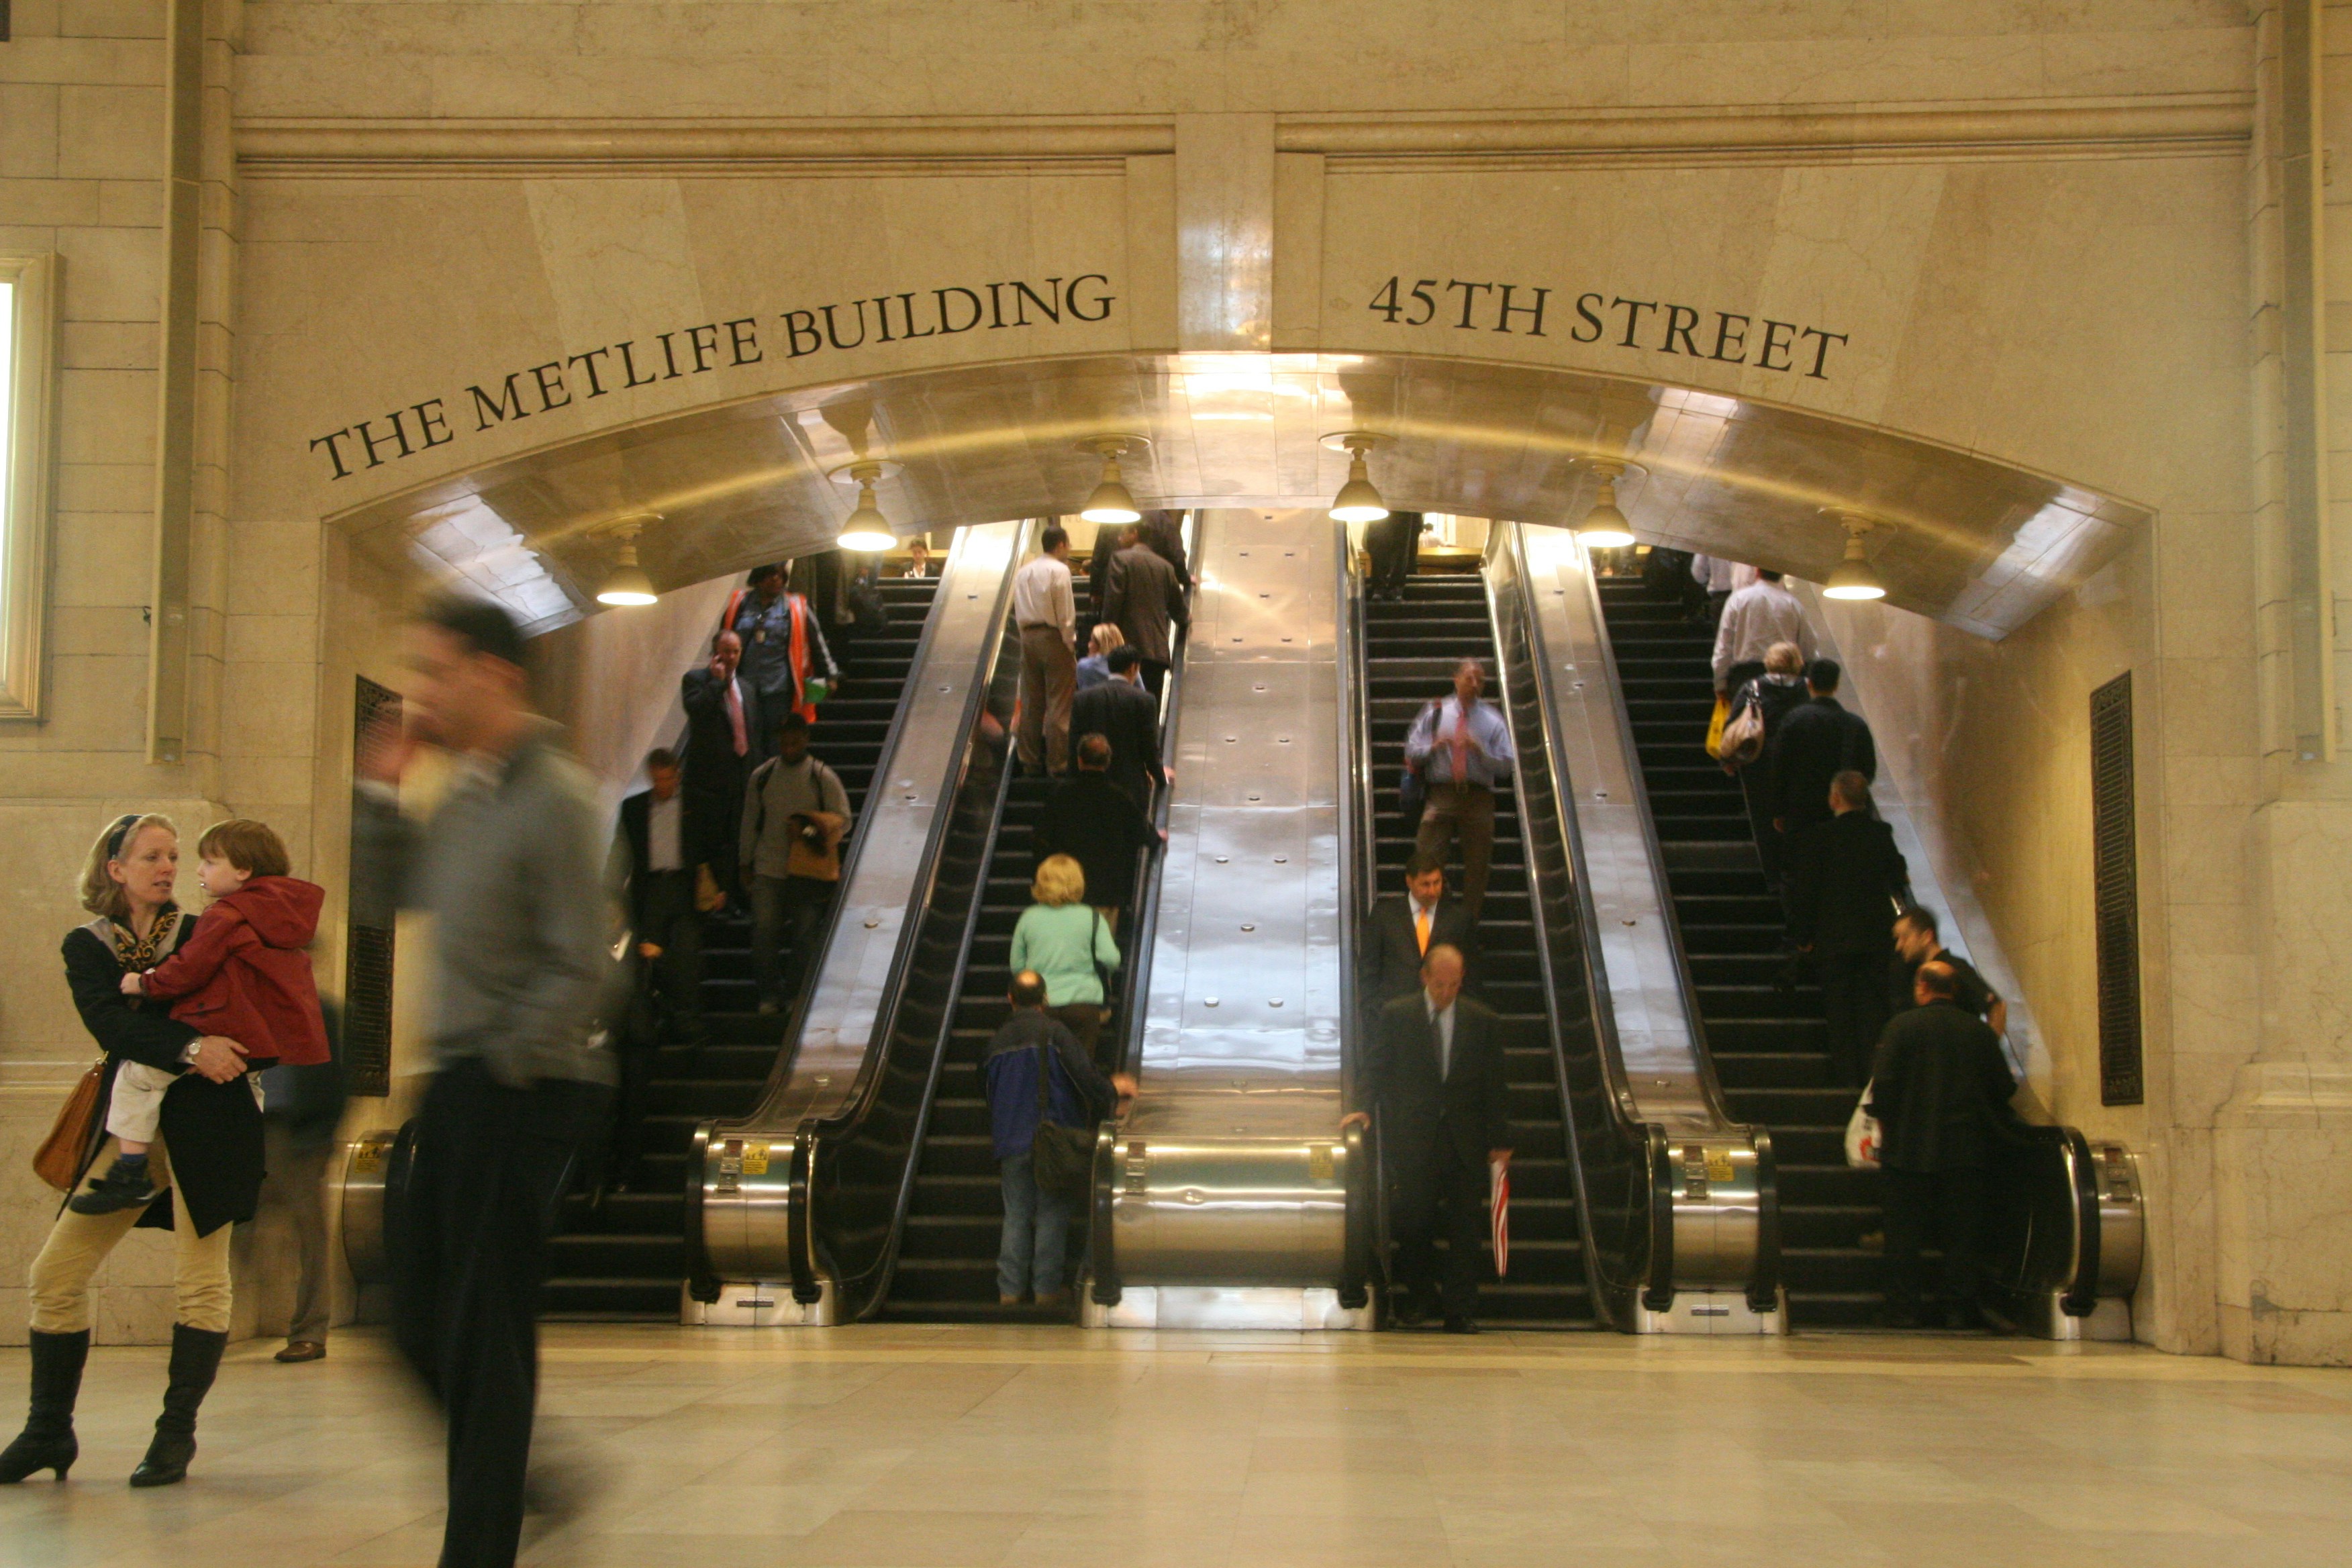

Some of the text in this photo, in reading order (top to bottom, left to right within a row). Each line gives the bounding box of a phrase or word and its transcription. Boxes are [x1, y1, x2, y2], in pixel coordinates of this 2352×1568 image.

[309, 274, 1116, 481] THE METLIFE BUILDING
[1369, 276, 1849, 381] 45TH STREET
